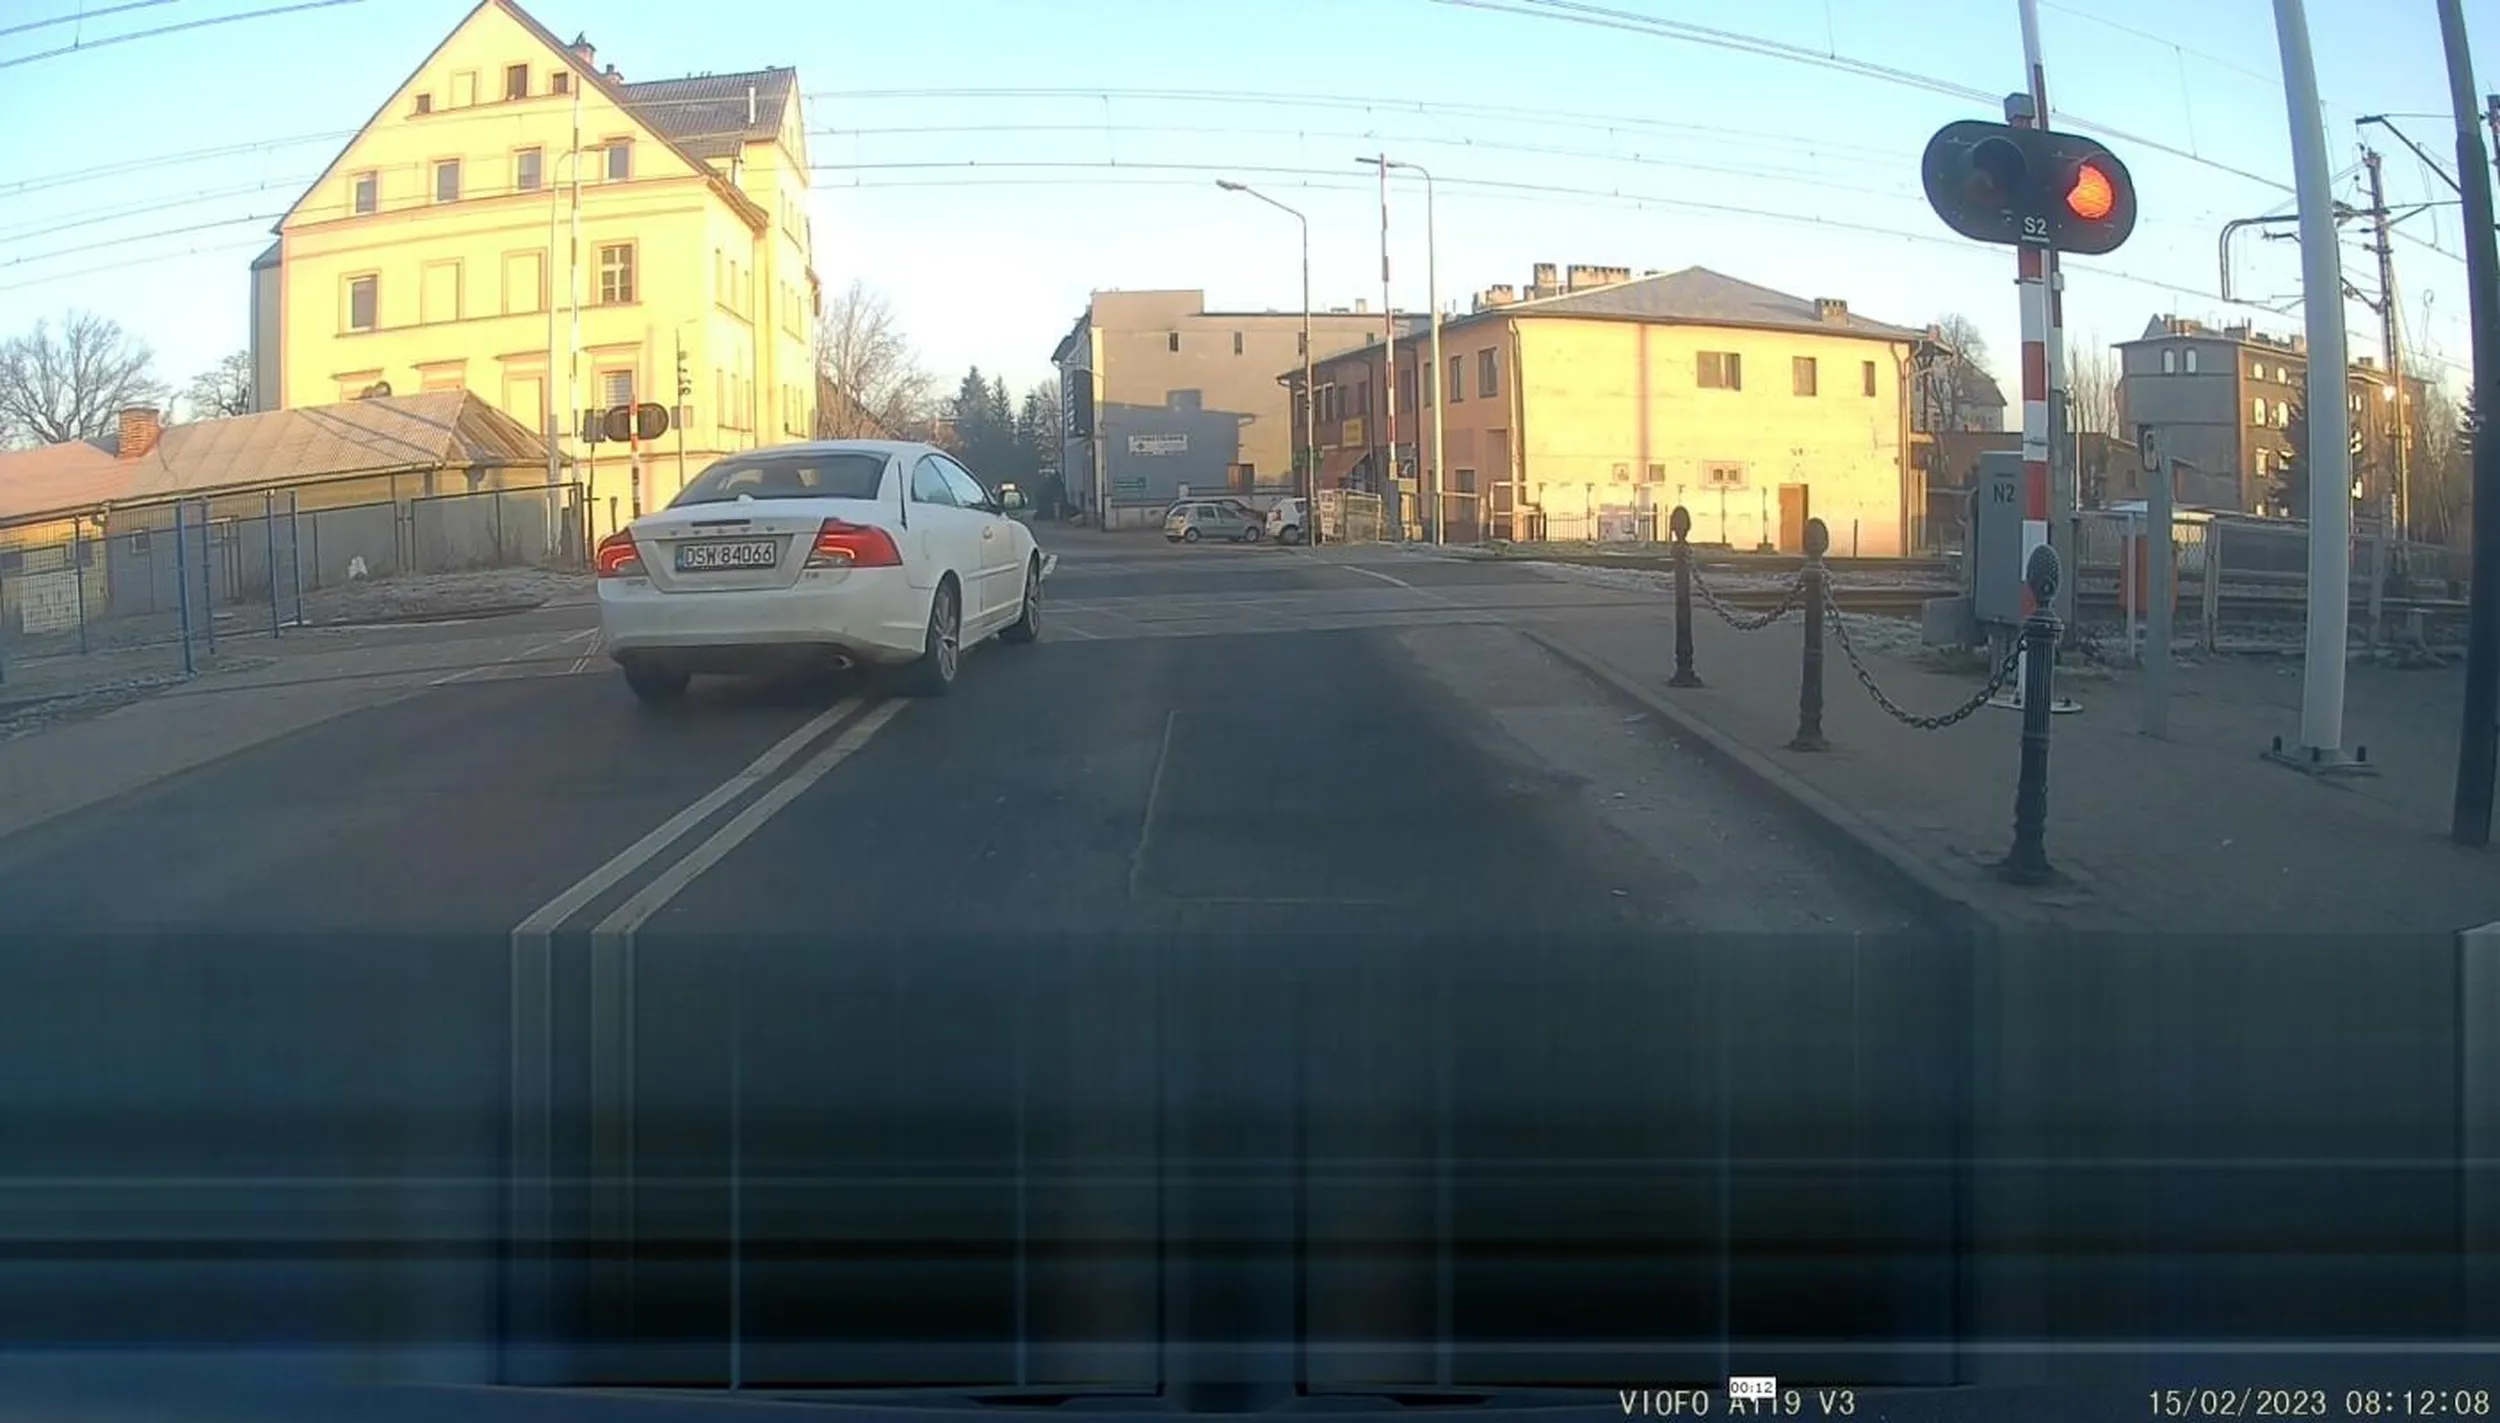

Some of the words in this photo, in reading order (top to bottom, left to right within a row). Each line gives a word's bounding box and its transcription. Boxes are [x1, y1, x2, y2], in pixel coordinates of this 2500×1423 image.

[2024, 216, 2047, 235] S2
[1993, 483, 2015, 504] N2
[685, 547, 716, 566] DSW
[722, 545, 772, 563] 84066
